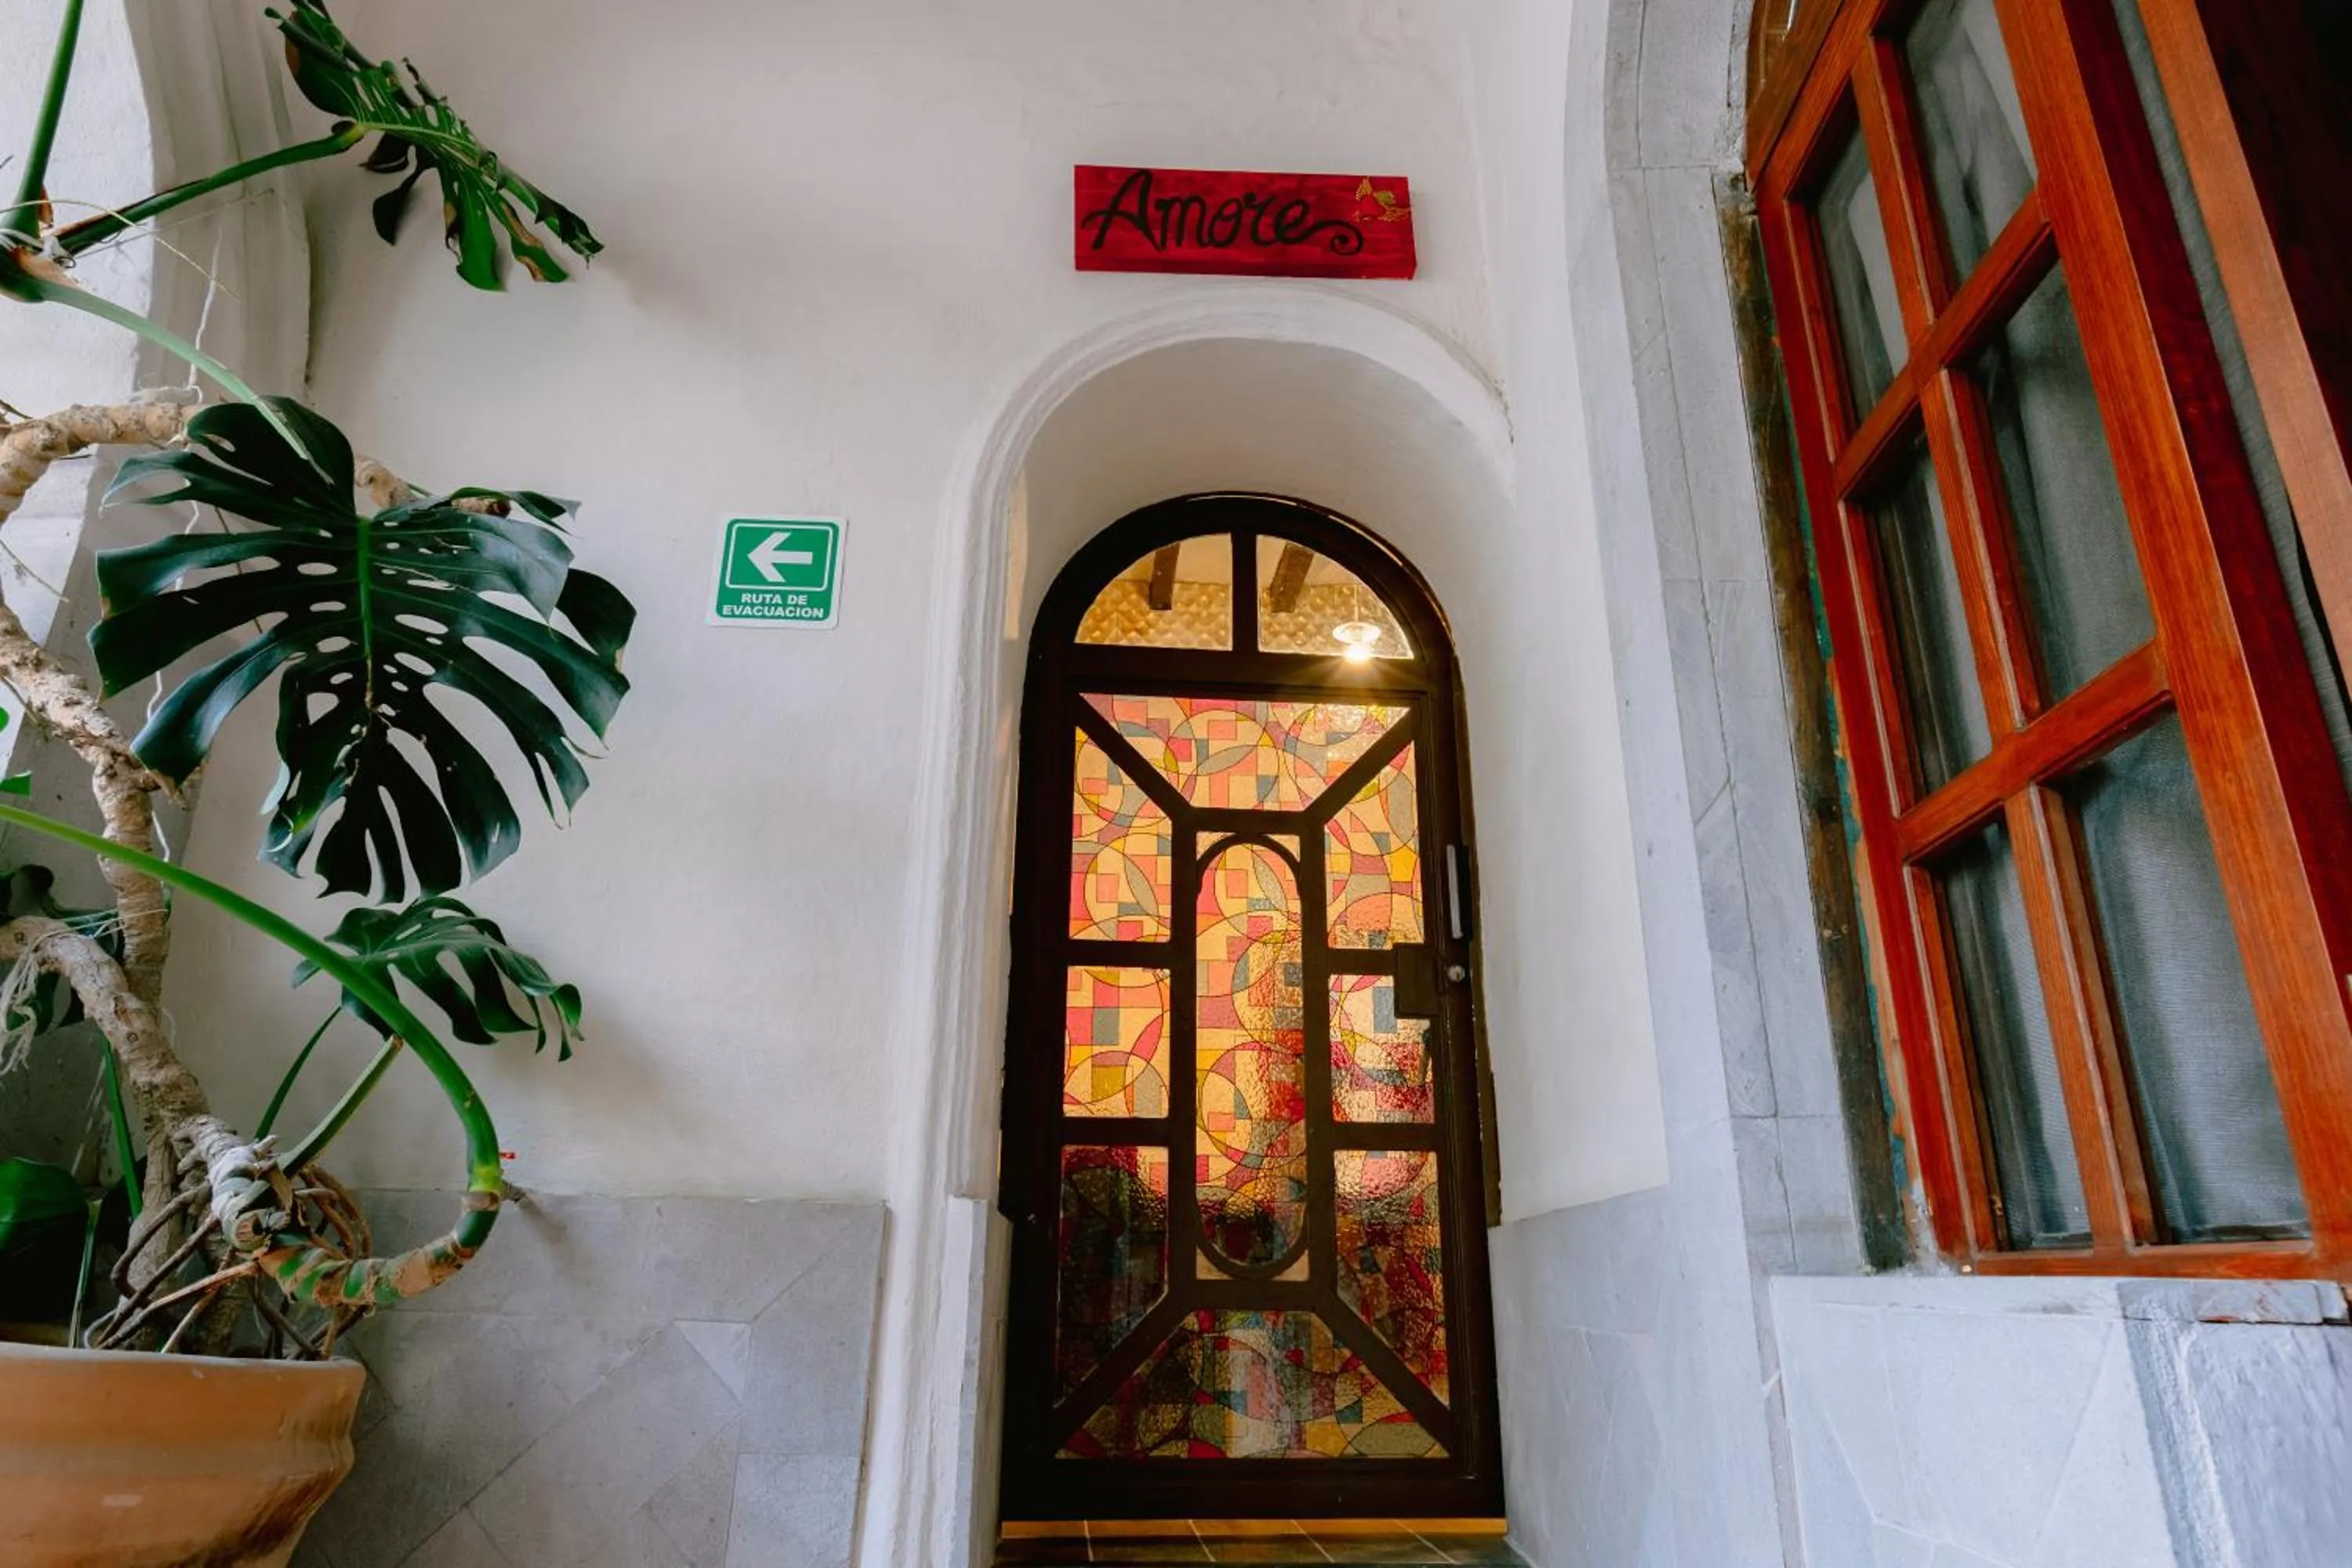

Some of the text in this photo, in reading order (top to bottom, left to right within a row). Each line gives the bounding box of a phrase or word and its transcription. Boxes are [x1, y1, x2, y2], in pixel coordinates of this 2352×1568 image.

[1080, 169, 1364, 256] Amore
[741, 593, 808, 605] RUTA DE
[722, 604, 824, 618] EVACUACION
